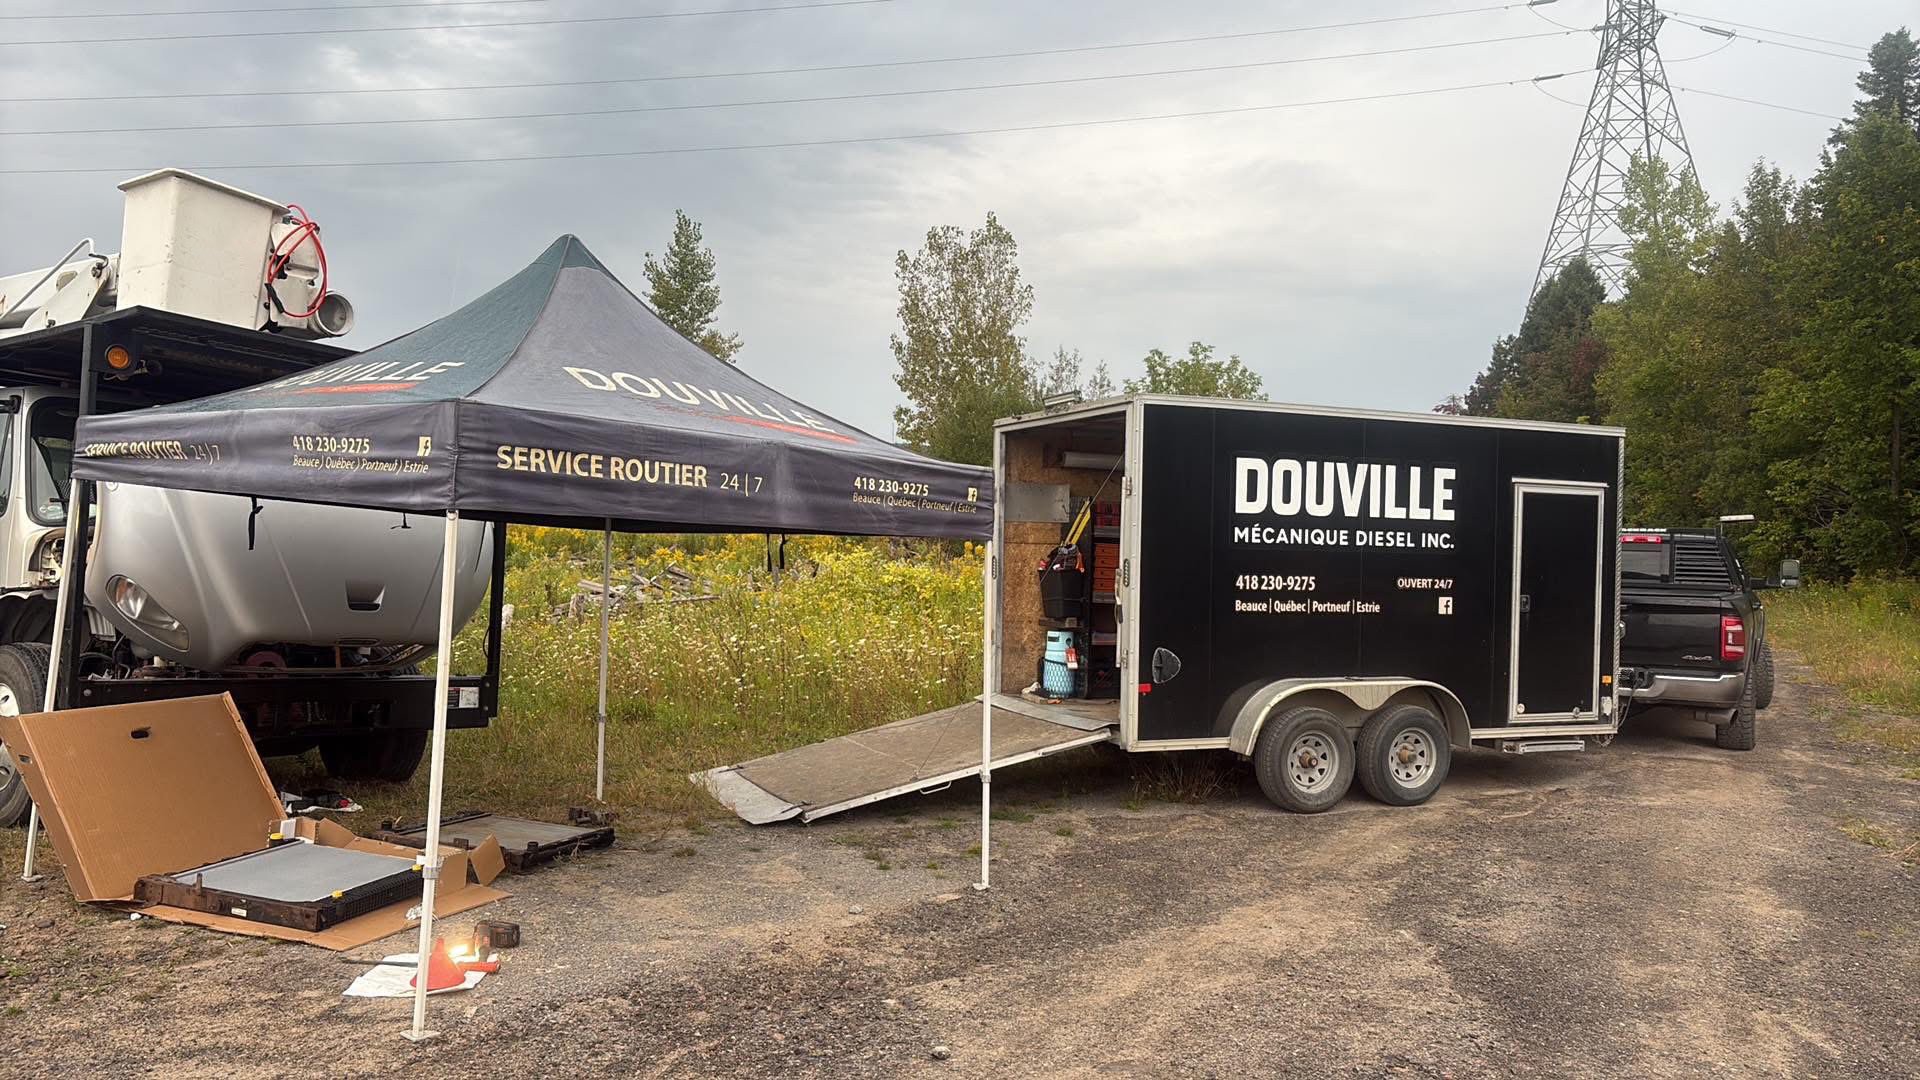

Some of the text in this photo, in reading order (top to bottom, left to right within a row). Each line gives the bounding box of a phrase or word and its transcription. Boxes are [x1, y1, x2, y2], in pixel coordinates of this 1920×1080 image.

[248, 361, 465, 392] OUVILLE
[562, 366, 835, 433] DOUVILLE
[129, 440, 188, 460] ROUTIER
[292, 435, 370, 454] 418 230-9275
[293, 455, 429, 474] Beauce Québec Portneuf Estrie
[496, 445, 604, 478] SERVICE
[609, 456, 708, 488] ROUTIER
[854, 476, 929, 497] 418 230-9275
[1234, 457, 1456, 521] DOUVILLE
[852, 492, 881, 505] Beauce
[887, 496, 916, 508] Québec
[921, 499, 953, 511] Portneuf
[1234, 523, 1455, 549] MÉCANIQUE DIESEL INC.
[1235, 575, 1316, 591] 418 230-9275
[1397, 578, 1453, 590] OUVERT 24/7
[1235, 599, 1381, 613] Beauce Québec Portneuf Estrie
